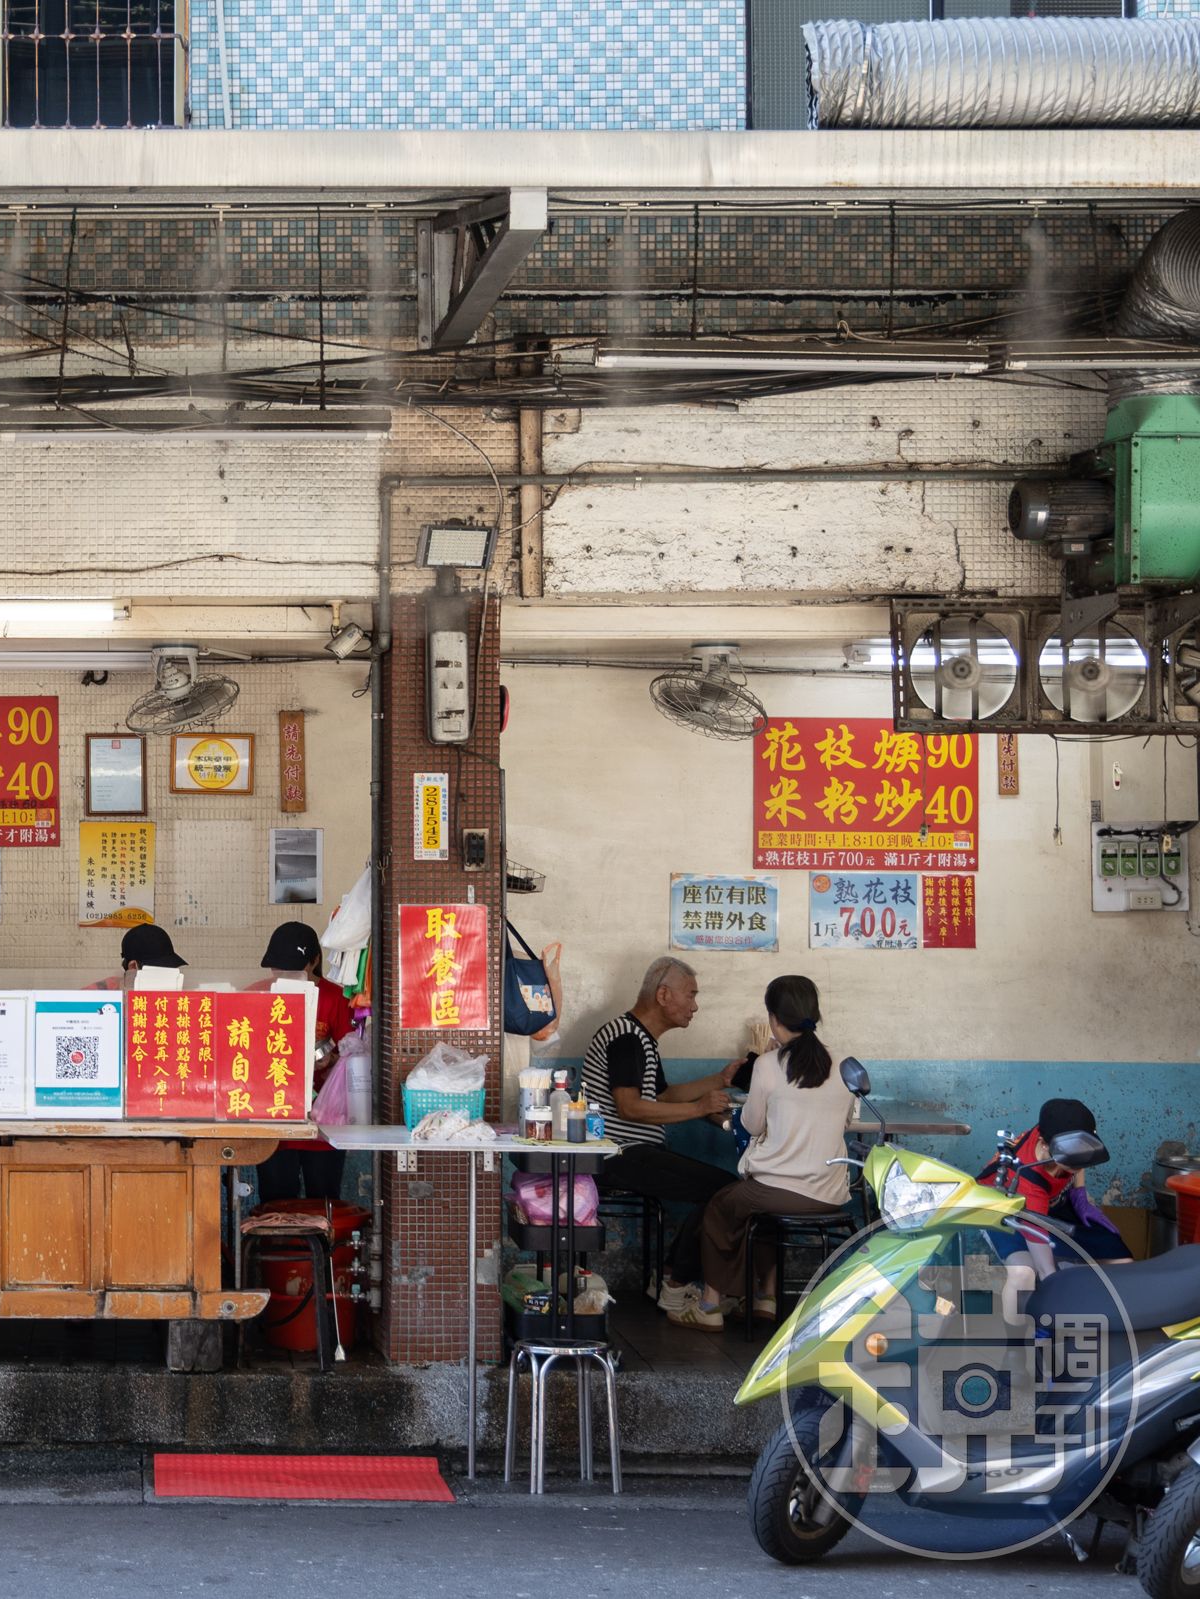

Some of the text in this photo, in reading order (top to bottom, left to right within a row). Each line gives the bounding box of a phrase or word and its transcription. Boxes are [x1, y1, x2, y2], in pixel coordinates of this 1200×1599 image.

[7, 706, 53, 746] 90
[282, 722, 304, 802] 請先付款
[926, 733, 973, 769] 90
[6, 761, 54, 801] 40
[425, 787, 438, 846] 281545
[764, 776, 973, 827] 米粉炒 40
[682, 885, 767, 905] 座位有限
[833, 877, 917, 906] 熟花枝
[682, 910, 767, 931] 禁帶外食
[695, 934, 753, 945] 感謝您的合作
[813, 922, 838, 938] 1斤
[424, 908, 462, 1026] 取餐區
[226, 1017, 255, 1117] 請自取
[265, 995, 296, 1118] 免洗餐具
